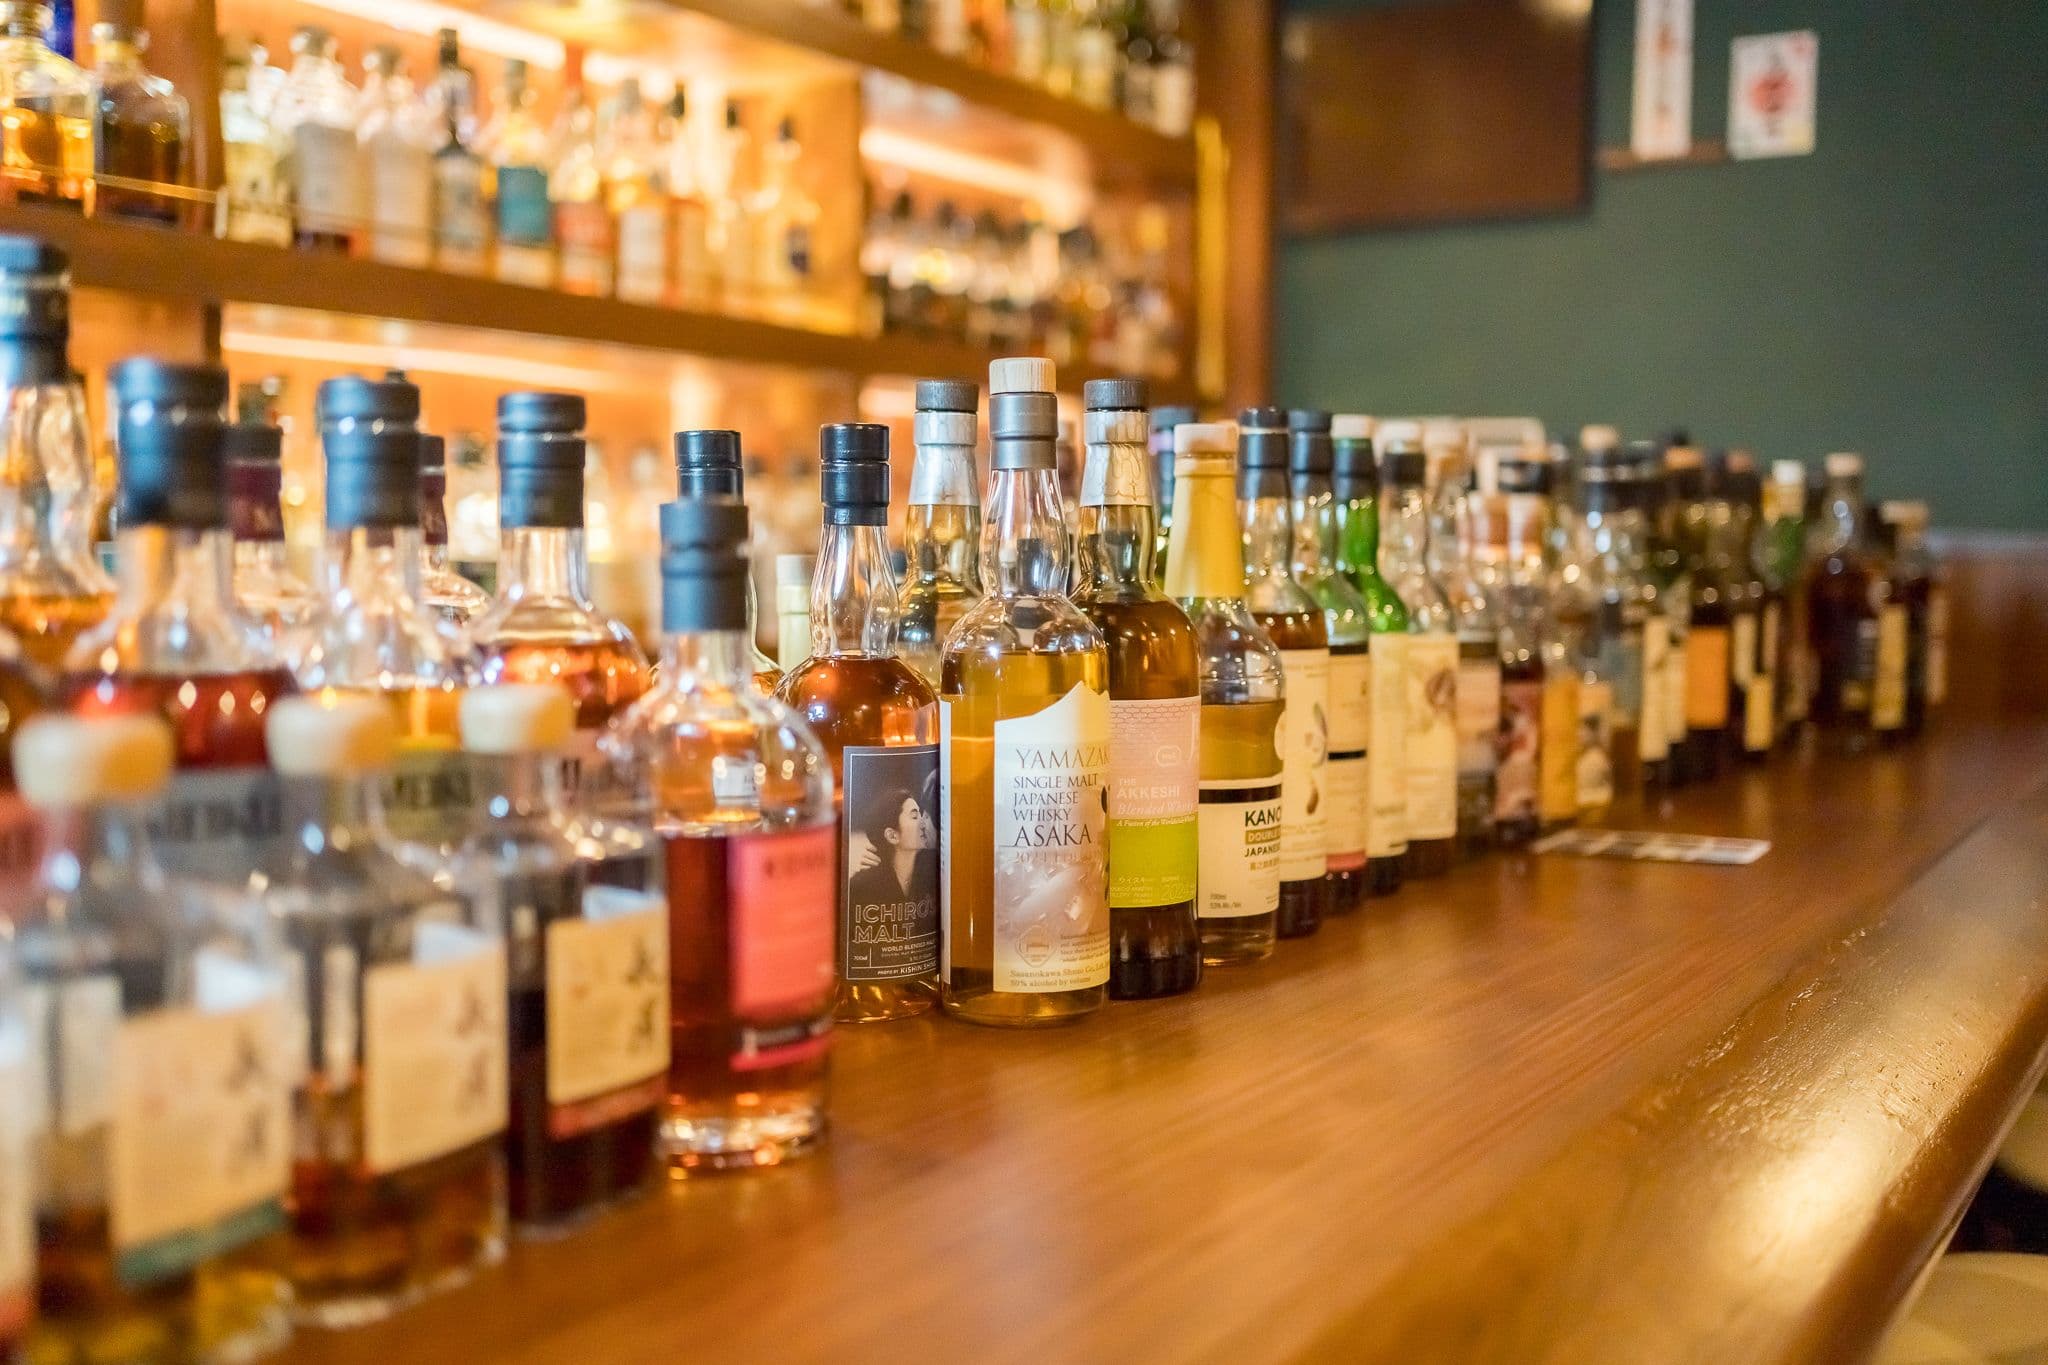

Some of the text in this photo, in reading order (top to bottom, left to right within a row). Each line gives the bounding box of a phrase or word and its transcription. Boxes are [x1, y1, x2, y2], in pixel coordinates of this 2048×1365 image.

[1013, 773, 1098, 789] SINGLE MALT
[1119, 776, 1137, 786] THE
[1013, 791, 1079, 807] JAPANESE
[1116, 785, 1180, 800] AKKESHI
[1013, 808, 1072, 821] WHISKY
[1118, 801, 1165, 817] Blended
[1013, 824, 1092, 847] ASAKA
[855, 922, 915, 944] MALT
[881, 944, 903, 953] WORLD
[900, 964, 922, 975] KISHIN
